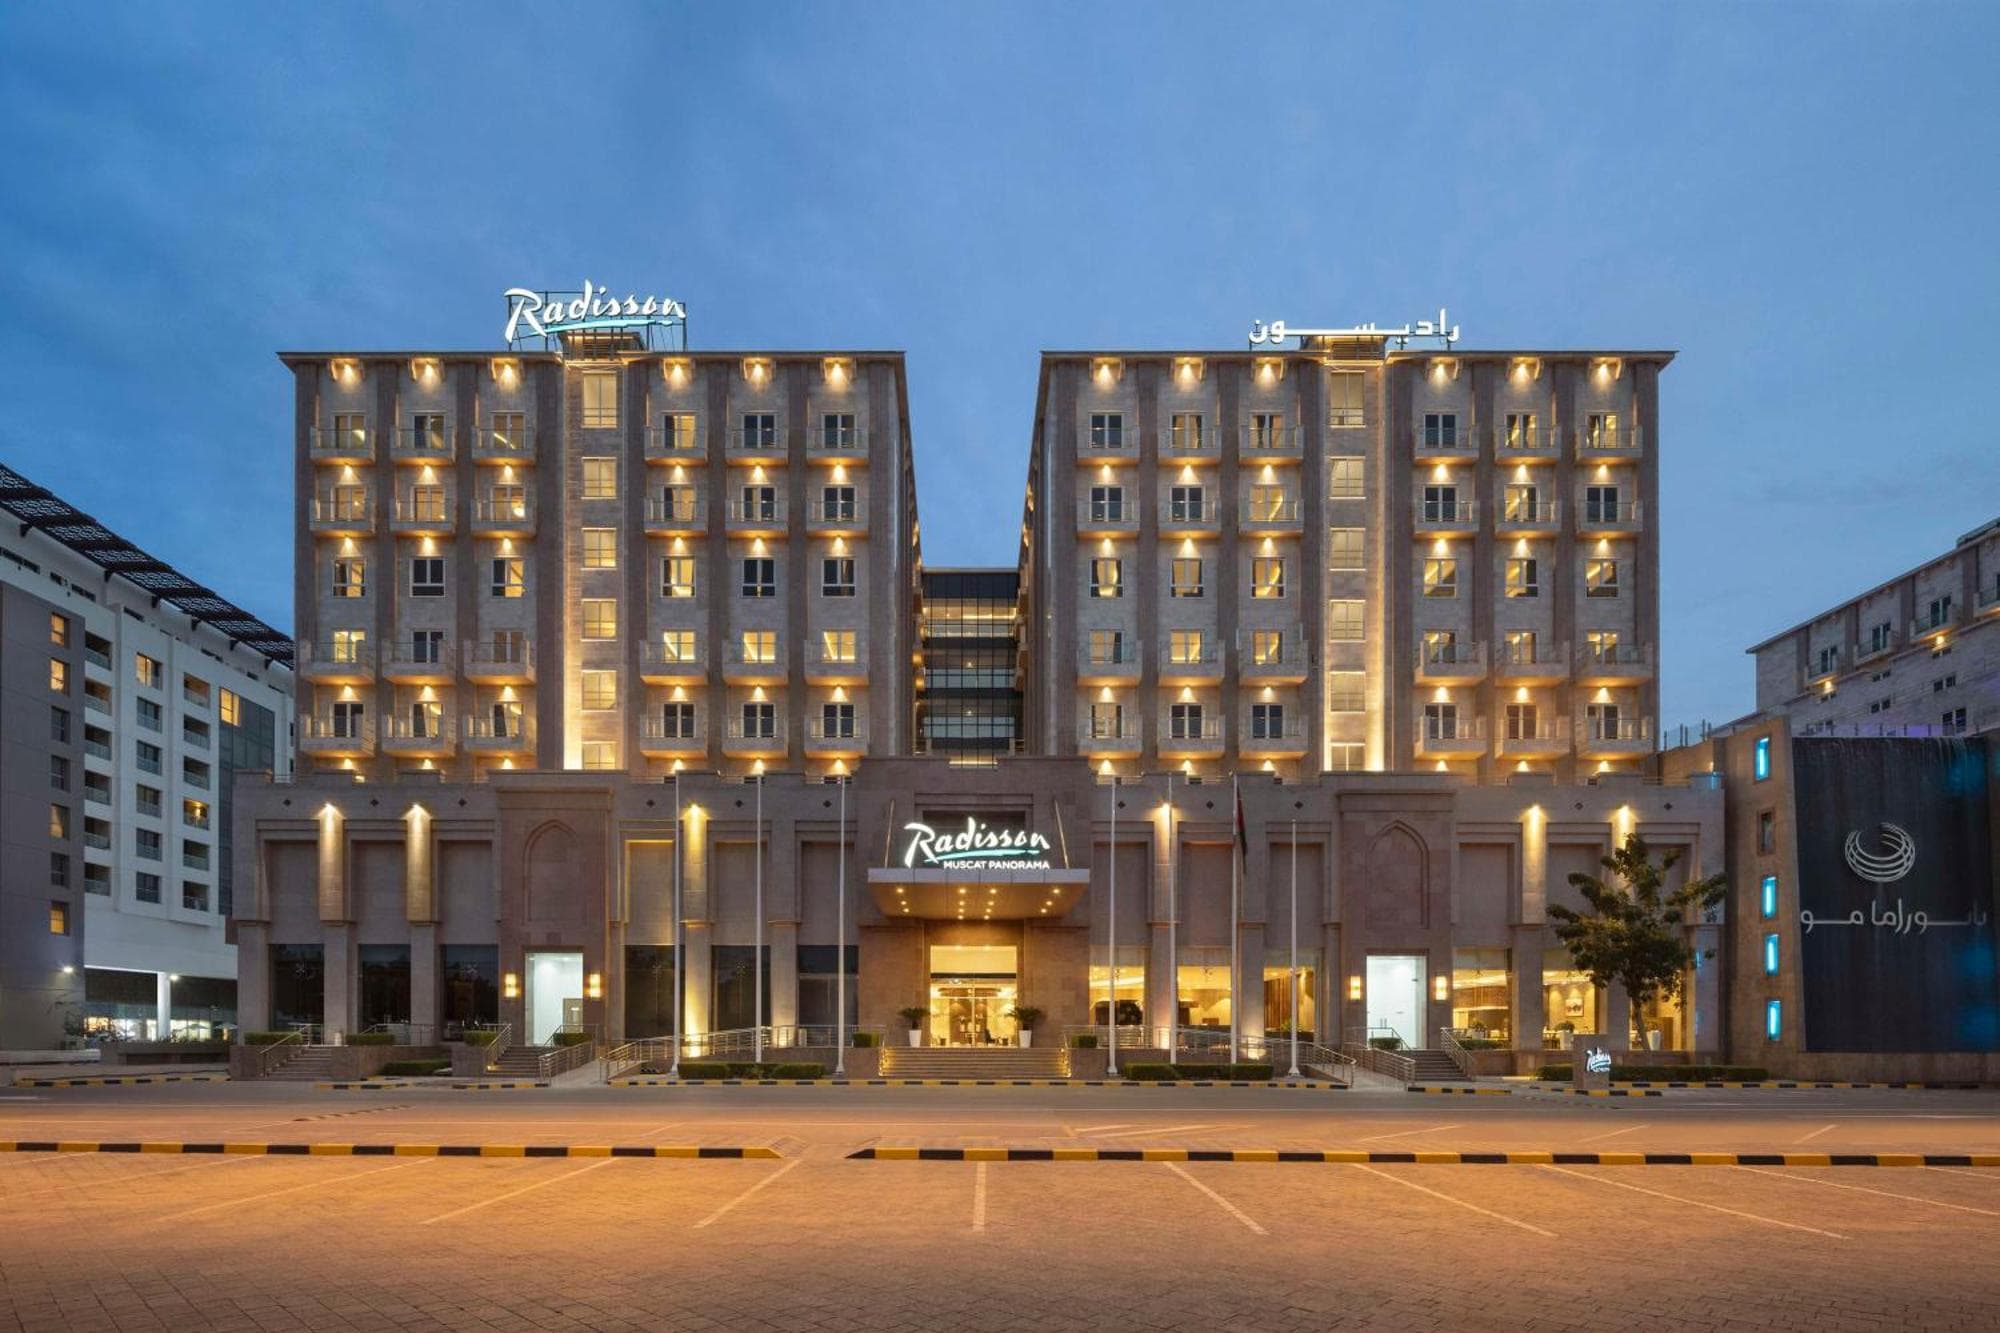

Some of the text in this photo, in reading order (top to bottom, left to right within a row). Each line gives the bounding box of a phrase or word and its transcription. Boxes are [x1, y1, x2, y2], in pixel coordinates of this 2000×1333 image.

[504, 279, 687, 343] Radisson
[904, 816, 1051, 868] Radisson
[943, 859, 1051, 870] MUSCAT PANORAMA
